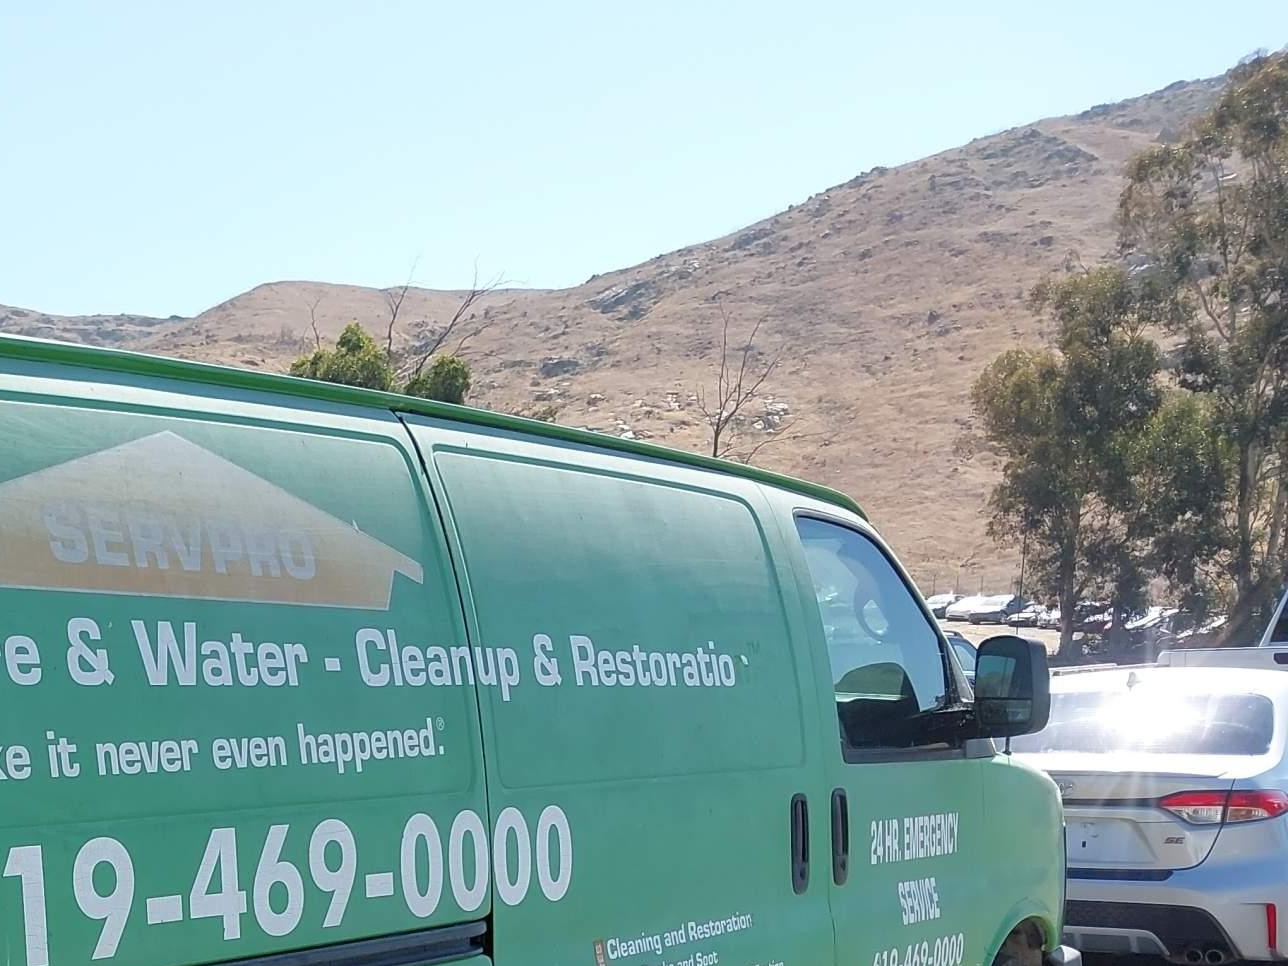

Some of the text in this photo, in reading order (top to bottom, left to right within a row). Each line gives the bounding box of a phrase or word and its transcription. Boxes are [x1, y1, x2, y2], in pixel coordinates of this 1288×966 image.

[42, 499, 318, 581] SERVPRO
[66, 617, 116, 686] &
[130, 620, 309, 687] Water
[355, 627, 521, 702] Cleanup
[533, 633, 562, 687] &
[569, 633, 749, 688] Restoratio
[45, 730, 80, 779] it
[96, 737, 199, 777] never
[212, 732, 288, 770] even
[871, 820, 883, 865] 24
[903, 812, 960, 861] EMERGENCY
[1164, 836, 1185, 845] SE
[898, 877, 941, 926] SERVICE
[607, 911, 753, 960] Cleaning and Restoration
